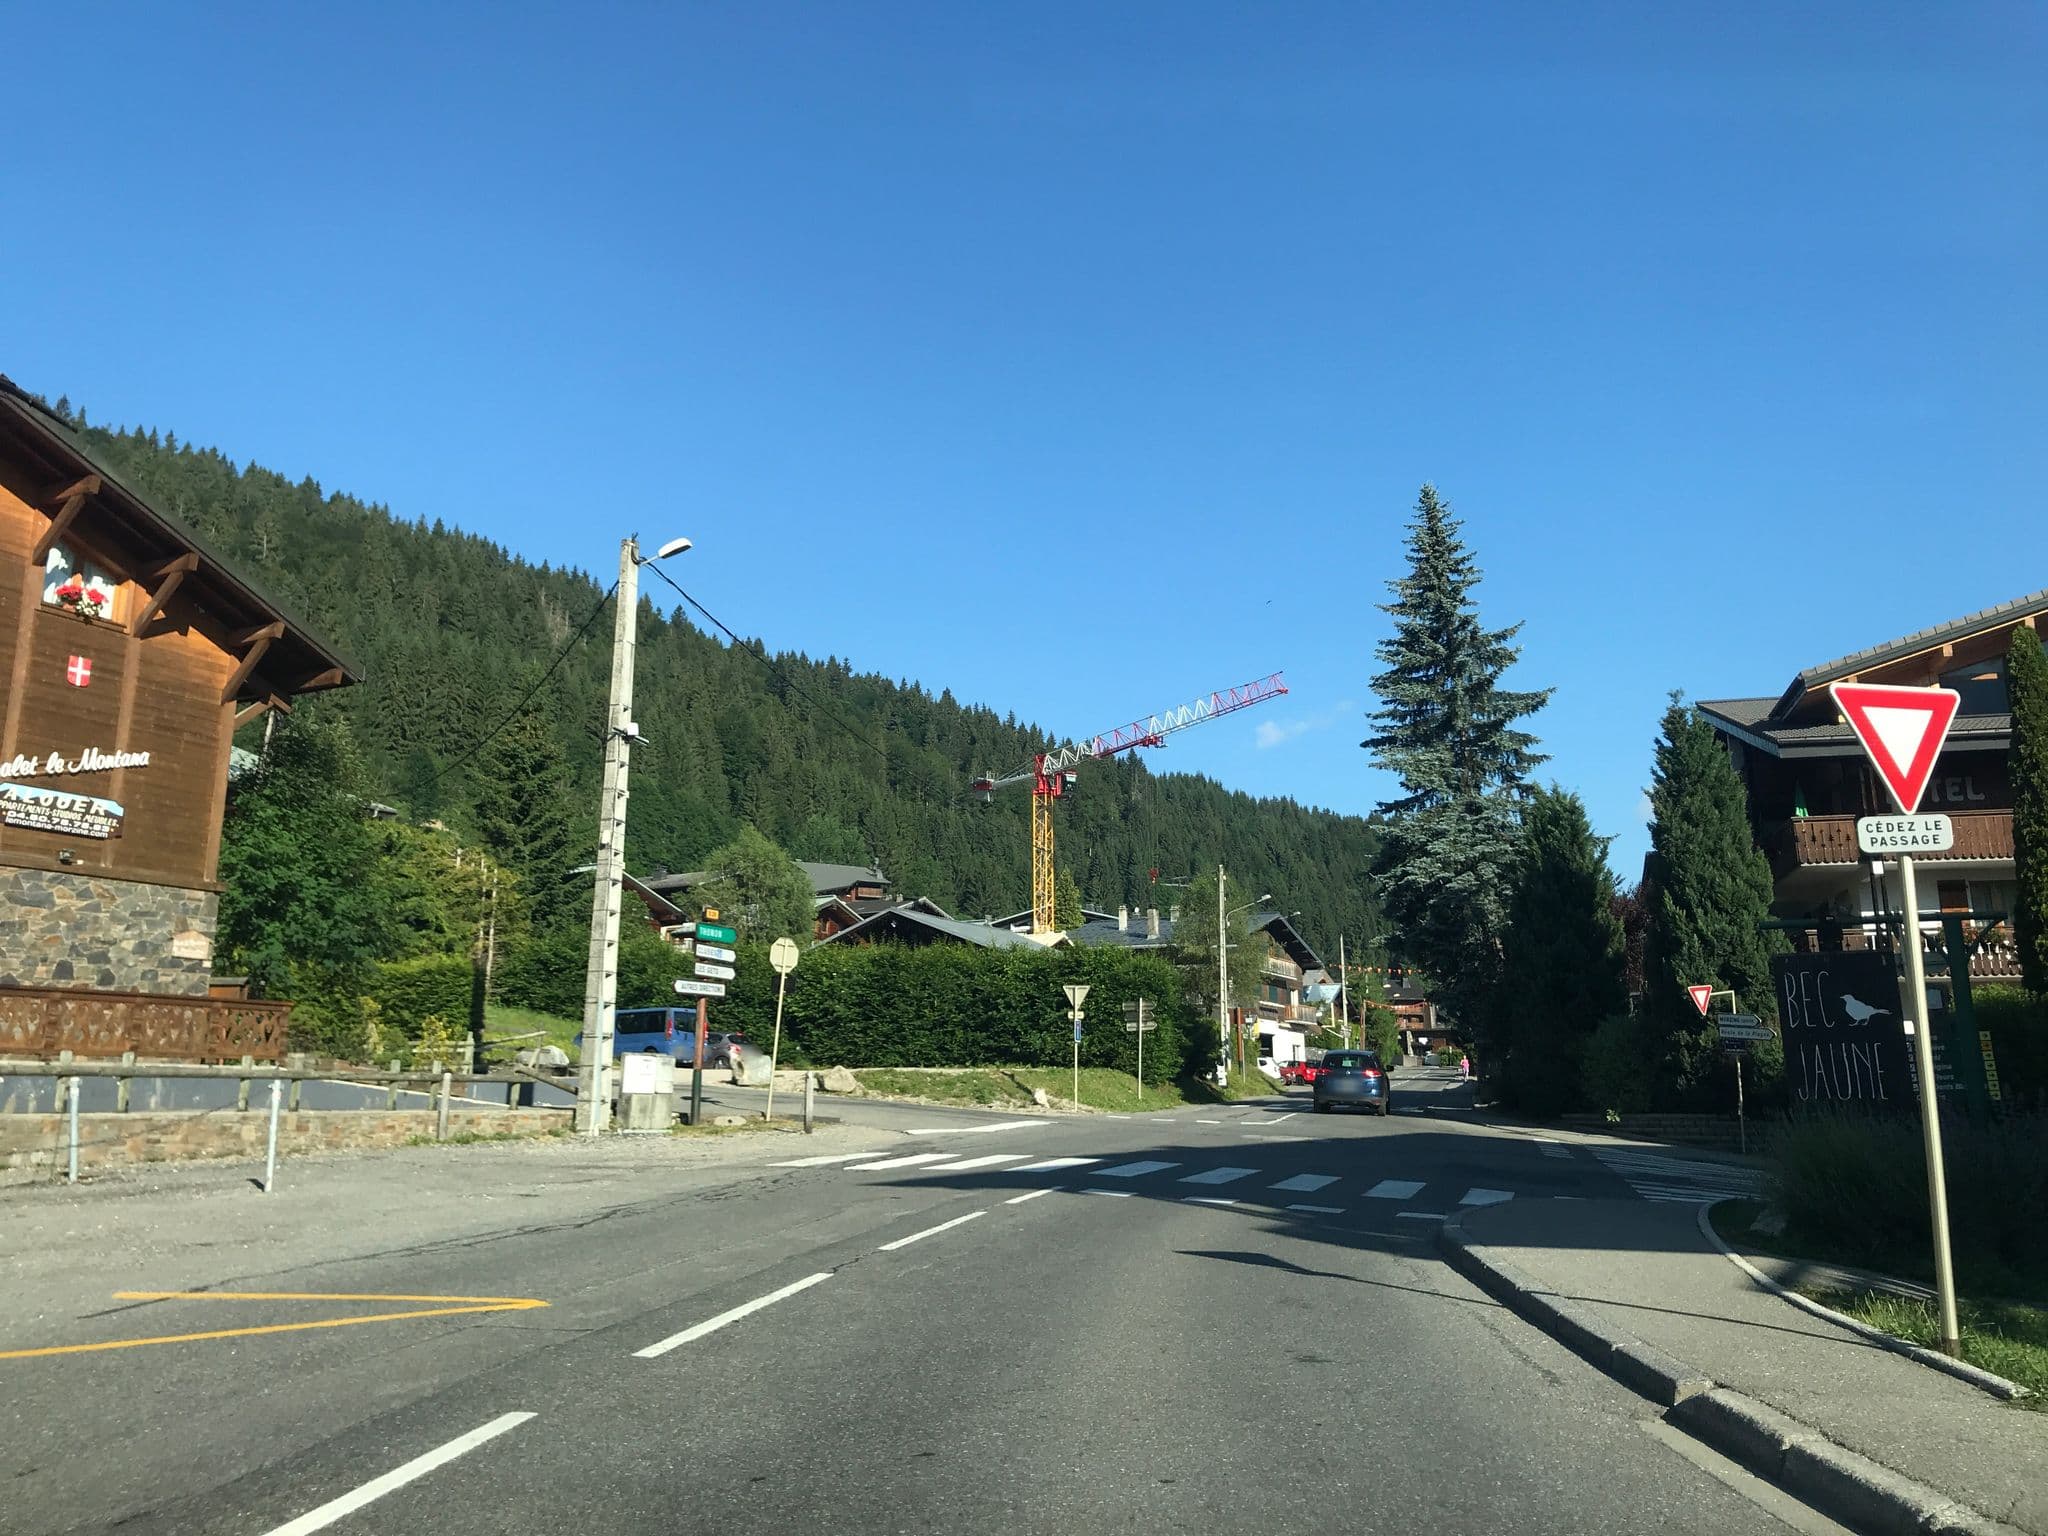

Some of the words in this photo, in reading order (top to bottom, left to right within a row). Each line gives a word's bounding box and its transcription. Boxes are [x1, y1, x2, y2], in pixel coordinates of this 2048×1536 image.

[45, 751, 64, 773] le
[67, 747, 150, 773] Montana
[1866, 821, 1916, 833] CÉDEZ
[1925, 820, 1943, 831] LE
[1870, 834, 1941, 847] PASSAGE
[1784, 971, 1835, 1028] BEC
[1799, 1042, 1888, 1101] JAUNE
